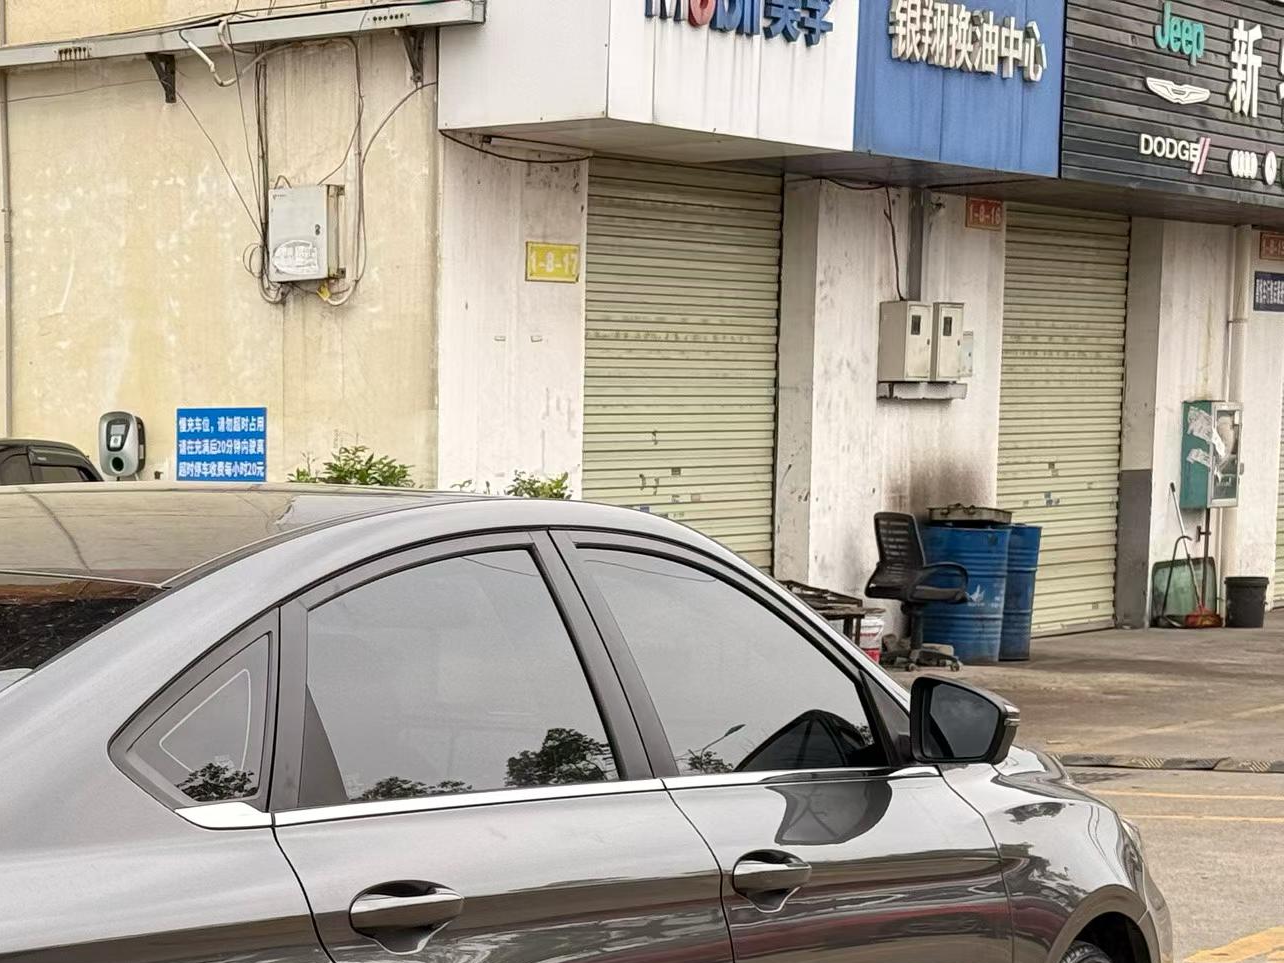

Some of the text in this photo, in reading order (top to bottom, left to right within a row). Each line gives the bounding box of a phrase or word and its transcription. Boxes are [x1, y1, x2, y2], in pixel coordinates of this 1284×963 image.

[889, 0, 1047, 82] 银翔换油中心
[1155, 2, 1205, 66] Jeep
[1229, 20, 1284, 122] 新
[1140, 134, 1202, 162] DODGE
